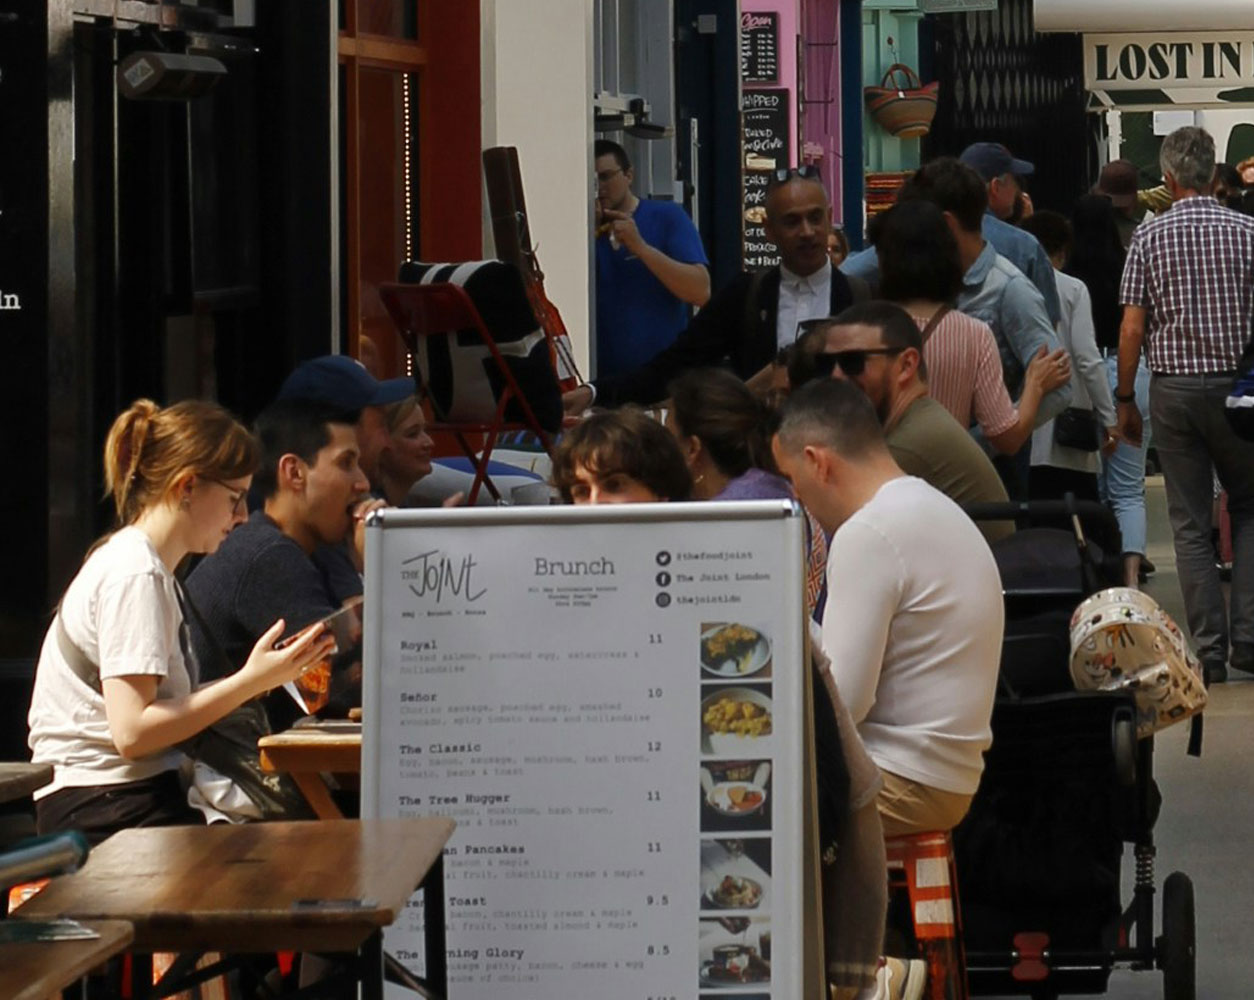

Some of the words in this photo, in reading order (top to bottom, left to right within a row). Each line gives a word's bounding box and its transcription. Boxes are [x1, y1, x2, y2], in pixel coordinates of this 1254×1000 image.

[1095, 42, 1194, 81] LOST
[1200, 42, 1242, 78] IN
[534, 557, 615, 576] Brunch
[677, 574, 693, 583] The
[699, 574, 728, 582] Joint
[735, 573, 770, 581] London
[400, 640, 437, 652] Royal
[649, 634, 663, 644] 11
[400, 691, 437, 702] Señor
[648, 688, 663, 698] 10
[400, 745, 421, 755] The
[429, 743, 481, 754] Classic
[648, 742, 661, 752] 12
[399, 796, 421, 806] The
[429, 795, 458, 805] Tree
[465, 793, 510, 805] Hugger
[648, 791, 661, 801] 11
[465, 844, 525, 855] Pancakes
[648, 843, 661, 852] 11
[450, 897, 486, 907] Toast
[647, 896, 669, 906] 9.5
[397, 949, 418, 959] The
[486, 948, 524, 960] Glory
